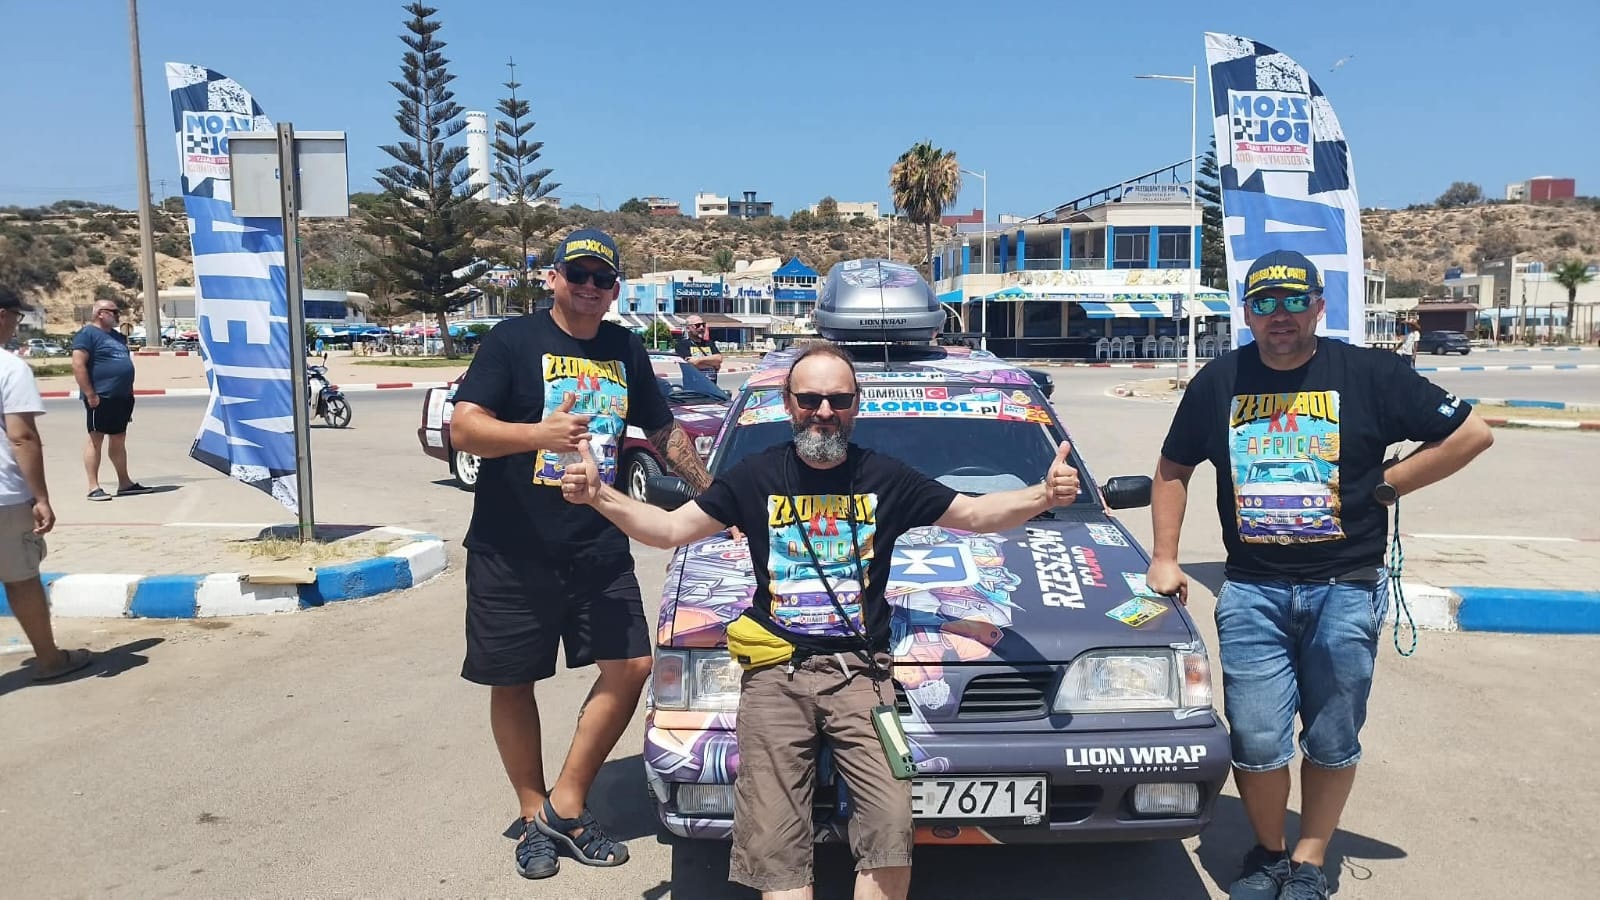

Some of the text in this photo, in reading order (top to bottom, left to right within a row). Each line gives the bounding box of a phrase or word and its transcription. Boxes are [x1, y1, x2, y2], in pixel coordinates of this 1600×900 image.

[860, 388, 924, 399] ŁOMBOL19
[1231, 392, 1338, 428] ZŁOMBOL
[1268, 408, 1299, 433] XX
[1247, 435, 1320, 455] AFRICA
[808, 511, 840, 536] XX
[1017, 527, 1086, 609] RZESZÓW
[1070, 545, 1107, 588] POLAND
[1066, 745, 1207, 766] LION WRAP
[1098, 765, 1178, 774] CAR WRAPPING
[936, 780, 1043, 815] 76714
